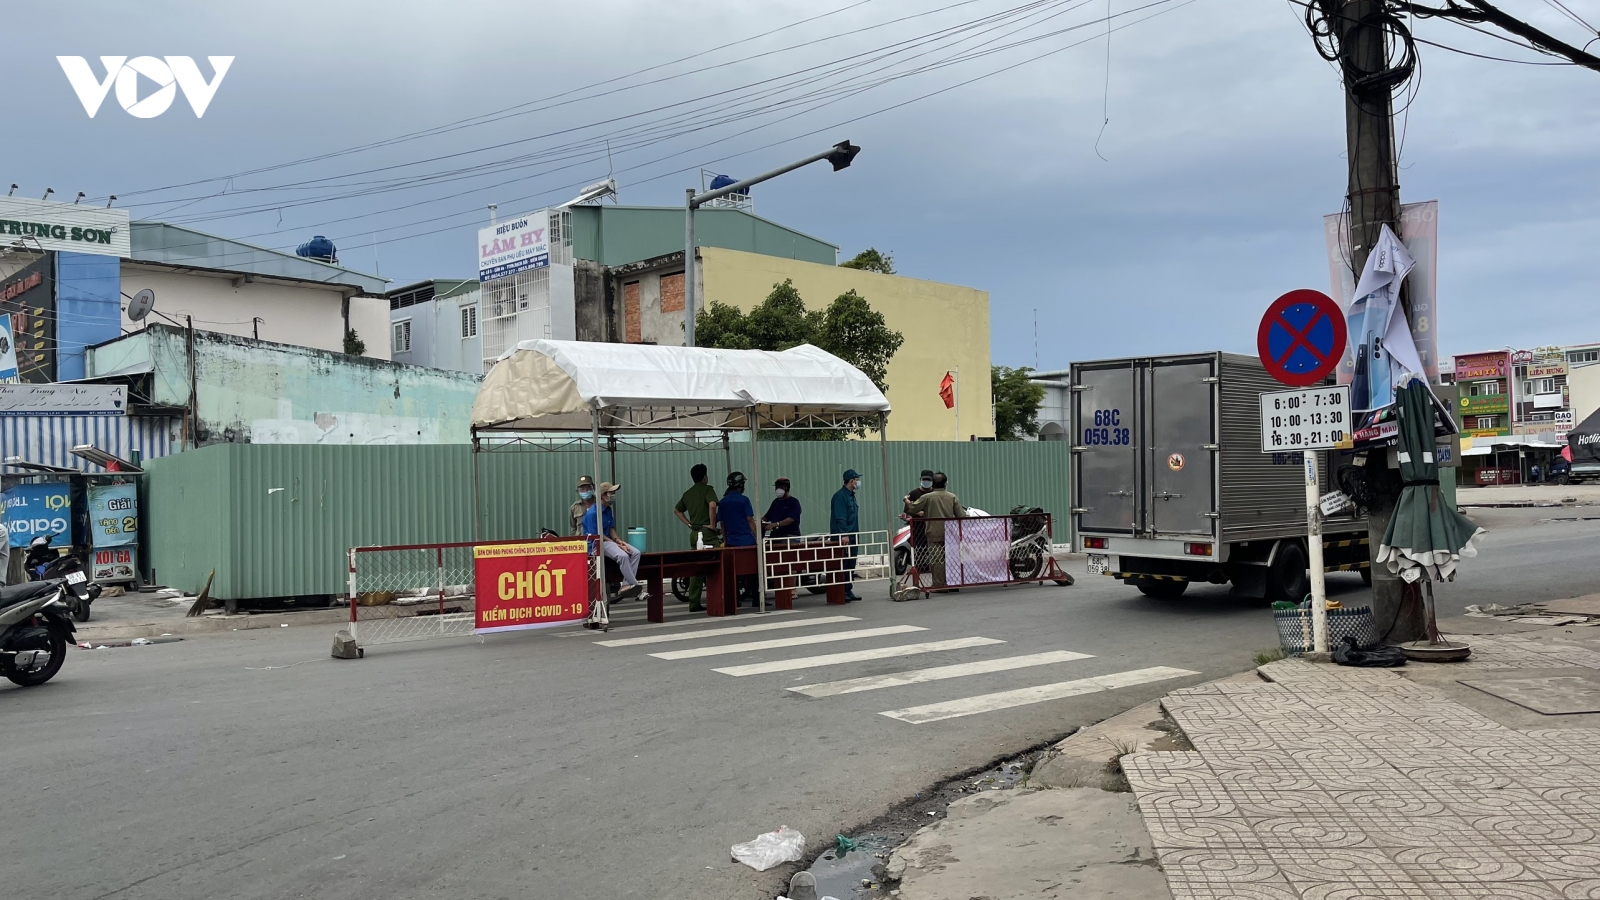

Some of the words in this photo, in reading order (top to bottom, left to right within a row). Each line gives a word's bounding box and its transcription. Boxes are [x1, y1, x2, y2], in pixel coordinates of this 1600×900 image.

[0, 219, 66, 241] TRUNG
[482, 236, 516, 258] LÂM
[520, 228, 545, 247] HY
[1094, 409, 1120, 426] 68C
[1084, 428, 1130, 446] 059.38
[108, 498, 131, 510] Giải
[498, 560, 566, 601] CHỐT
[483, 605, 507, 622] KIỂM
[510, 607, 532, 621] DỊCH
[535, 604, 562, 618] COVID
[571, 603, 582, 614] 19
